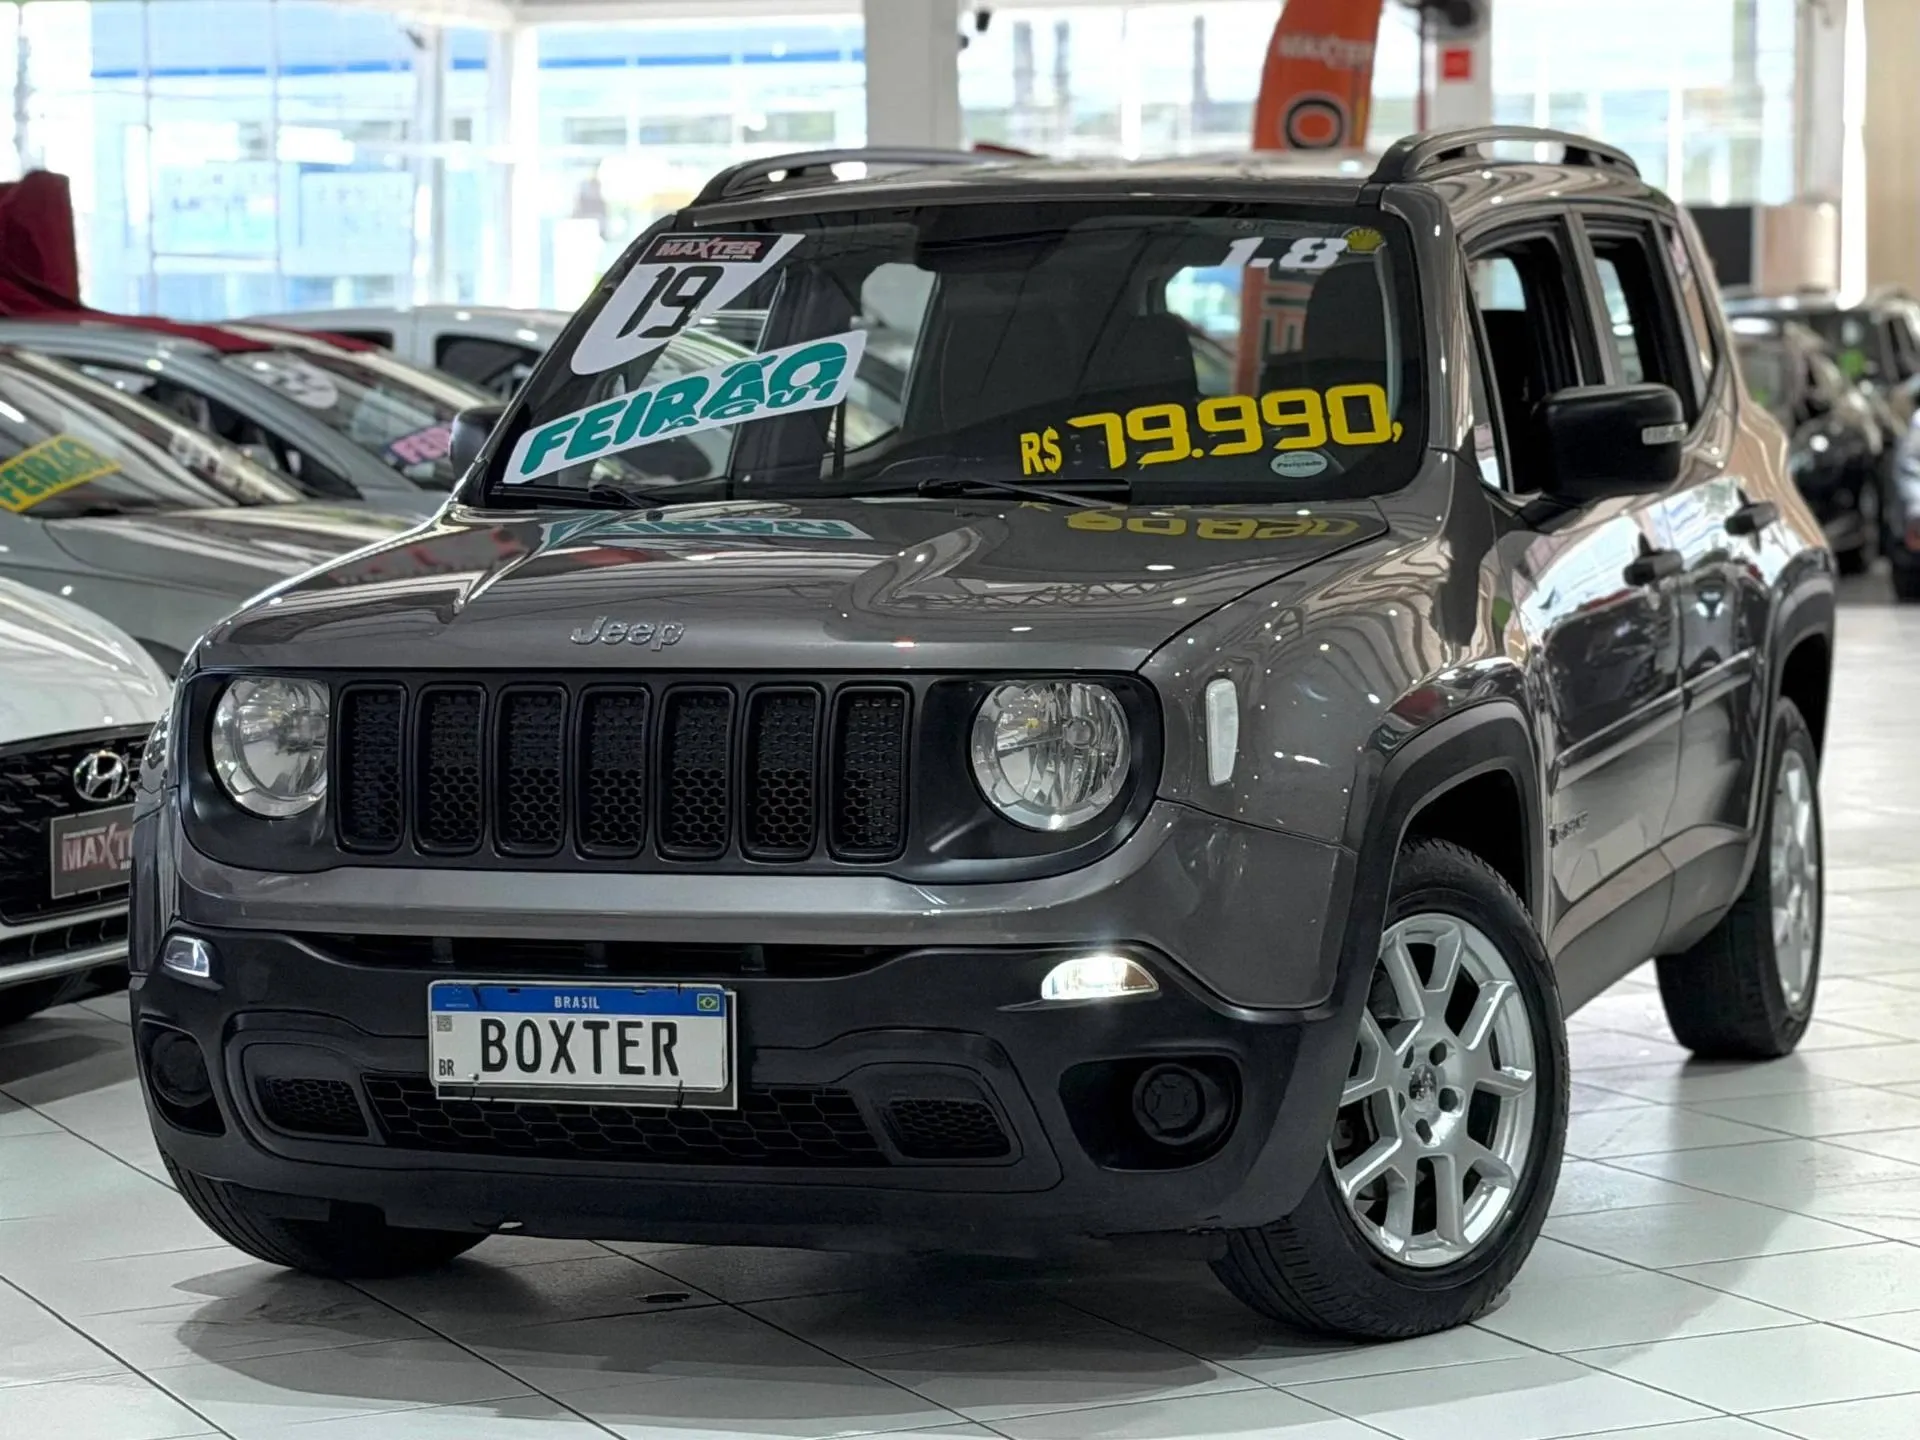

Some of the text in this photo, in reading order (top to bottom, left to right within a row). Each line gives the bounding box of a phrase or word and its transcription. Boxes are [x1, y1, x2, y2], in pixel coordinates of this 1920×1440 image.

[655, 237, 762, 259] MAXTER
[1219, 236, 1349, 269] 1.8
[616, 266, 725, 339] 19
[520, 342, 848, 475] FEIRÃO
[1020, 427, 1063, 474] R$
[570, 616, 685, 652] Jeep
[62, 822, 132, 871] MAXT
[554, 996, 600, 1010] BRASIL
[480, 1018, 680, 1076] BOXTER
[438, 1059, 455, 1077] BR
